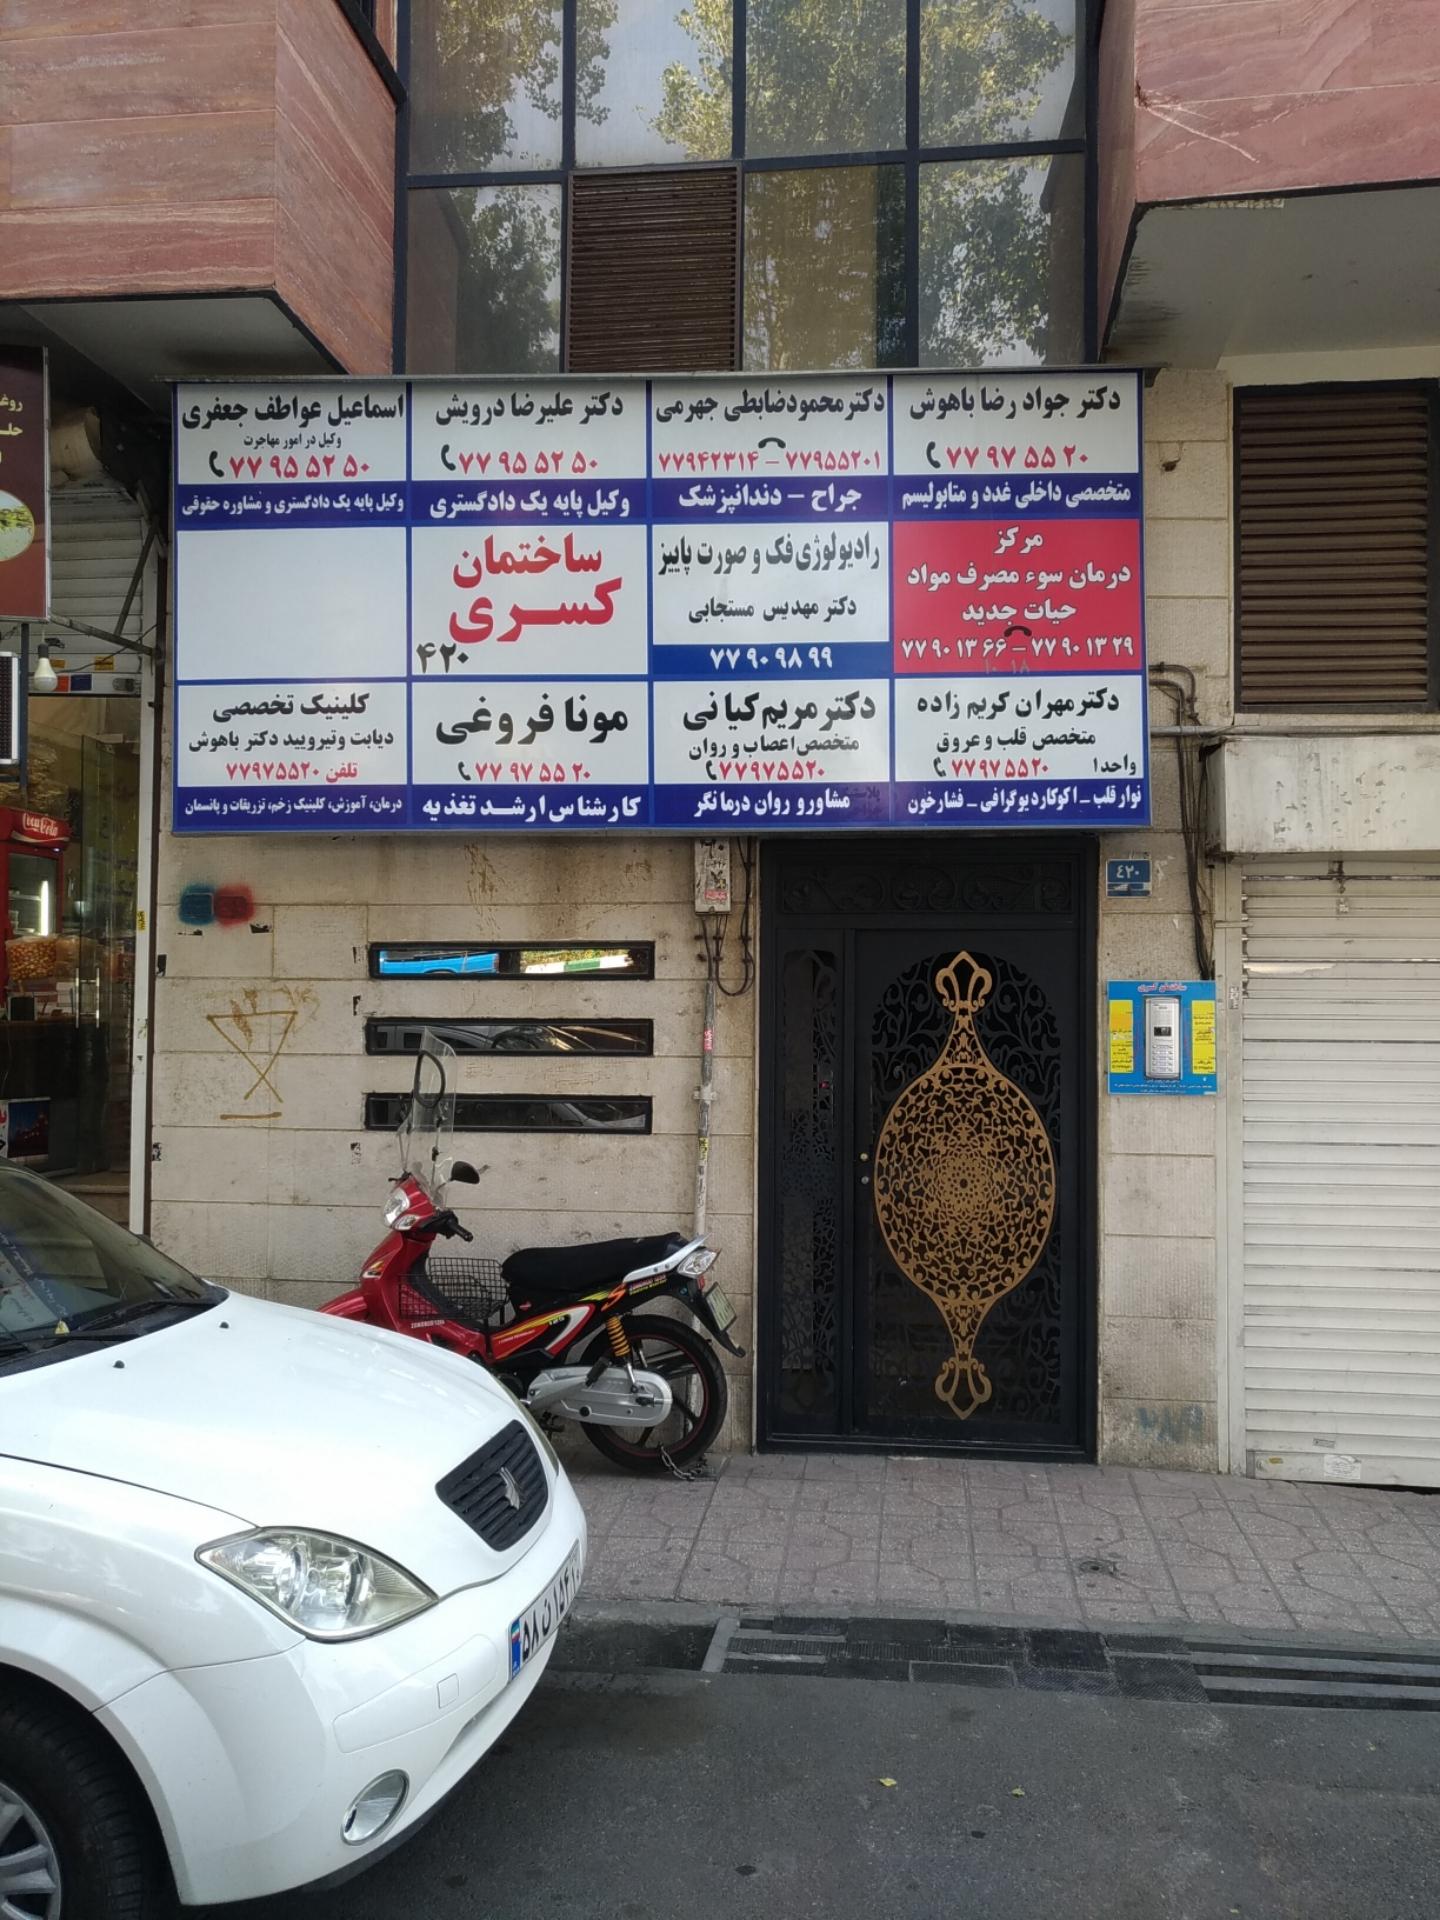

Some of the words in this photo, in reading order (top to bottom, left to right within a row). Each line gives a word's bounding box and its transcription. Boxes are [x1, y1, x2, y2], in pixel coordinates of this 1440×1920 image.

[0, 393, 23, 412] روغ
[182, 397, 248, 429] جعفری
[254, 395, 321, 428] عواطف
[328, 394, 404, 426] اسماعیل
[435, 394, 505, 425] درویش
[510, 392, 573, 425] علیرضا
[579, 392, 623, 424] دکتر
[656, 395, 718, 423] جهرمی
[844, 388, 884, 420] دکتر
[910, 387, 975, 420] باهوش
[981, 387, 1016, 419] رضا
[1023, 386, 1070, 419] جواد
[1076, 386, 1121, 418] دکتر
[0, 421, 24, 436] حل
[244, 433, 280, 449] مهاجرت
[284, 434, 302, 449] امور
[305, 435, 316, 448] در
[319, 433, 342, 448] وکیل
[182, 495, 220, 515] حقوقی
[274, 494, 330, 514] دادگستری
[332, 494, 351, 512] یک
[354, 494, 374, 514] پایه
[376, 493, 404, 515] وکیل
[430, 490, 516, 519] دادگستری
[520, 490, 548, 516] یک
[553, 489, 582, 518] پایه
[587, 488, 630, 517] وکیل
[678, 483, 782, 514] دندانپزشک
[811, 482, 862, 512] جراح
[902, 481, 966, 509] متابولیسم
[970, 490, 978, 509] و
[983, 481, 1011, 502] غدد
[1015, 480, 1062, 509] داخلی
[265, 501, 271, 514] و
[765, 533, 793, 564] فک
[795, 530, 879, 571] رادیولوژی
[994, 526, 1043, 554] مرکز
[453, 532, 601, 588] ساختمان
[658, 535, 692, 575] پاییز
[697, 542, 747, 574] صورت
[752, 547, 760, 574] و
[907, 563, 950, 591] مواد
[957, 561, 1019, 591] مصرف
[1025, 568, 1063, 590] سوء
[1068, 562, 1131, 589] درمان
[449, 576, 623, 643] کسری
[688, 596, 754, 623] مستجابی
[763, 599, 819, 622] مهدیس
[824, 595, 857, 622] دکتر
[962, 603, 1017, 625] جدید
[1023, 599, 1076, 625] حیات
[416, 642, 469, 673] ۴۲۰
[213, 694, 294, 722] تخصصی
[300, 692, 370, 720] کلینیک
[683, 691, 759, 731] کیانی
[762, 700, 818, 729] مریم
[818, 690, 876, 731] دکتر
[917, 690, 960, 719] زاده
[967, 691, 1010, 720] کریم
[1015, 689, 1075, 719] مهران
[1076, 687, 1119, 716] دکتر
[436, 692, 554, 744] فروغی
[564, 694, 628, 743] مونا
[189, 731, 239, 752] باهوش
[244, 730, 278, 752] دکتر
[350, 729, 394, 749] دیابت
[689, 737, 726, 760] روان
[732, 744, 739, 758] و
[743, 735, 795, 758] اعصاب
[797, 733, 859, 756] متخصص
[936, 733, 980, 753] عروق
[985, 736, 992, 750] و
[997, 727, 1027, 751] قلب
[1032, 727, 1096, 751] متخصص
[226, 761, 320, 780] ۷۷۹۷۵۵۲۰
[326, 762, 358, 783] تلفن
[1101, 754, 1137, 775] واحد
[185, 799, 221, 815] پانسمان
[231, 798, 266, 814] تزریقات
[293, 797, 326, 812] کلینیک
[423, 792, 476, 821] تغذیه
[480, 794, 546, 822] ارشد
[549, 795, 642, 823] کارشناس
[694, 791, 750, 817] درمانگر
[754, 791, 790, 815] روان
[981, 786, 1077, 812] اکوکاردیوگرافی
[1093, 785, 1116, 806] قلب
[1119, 784, 1141, 807] نوار
[223, 804, 227, 815] و
